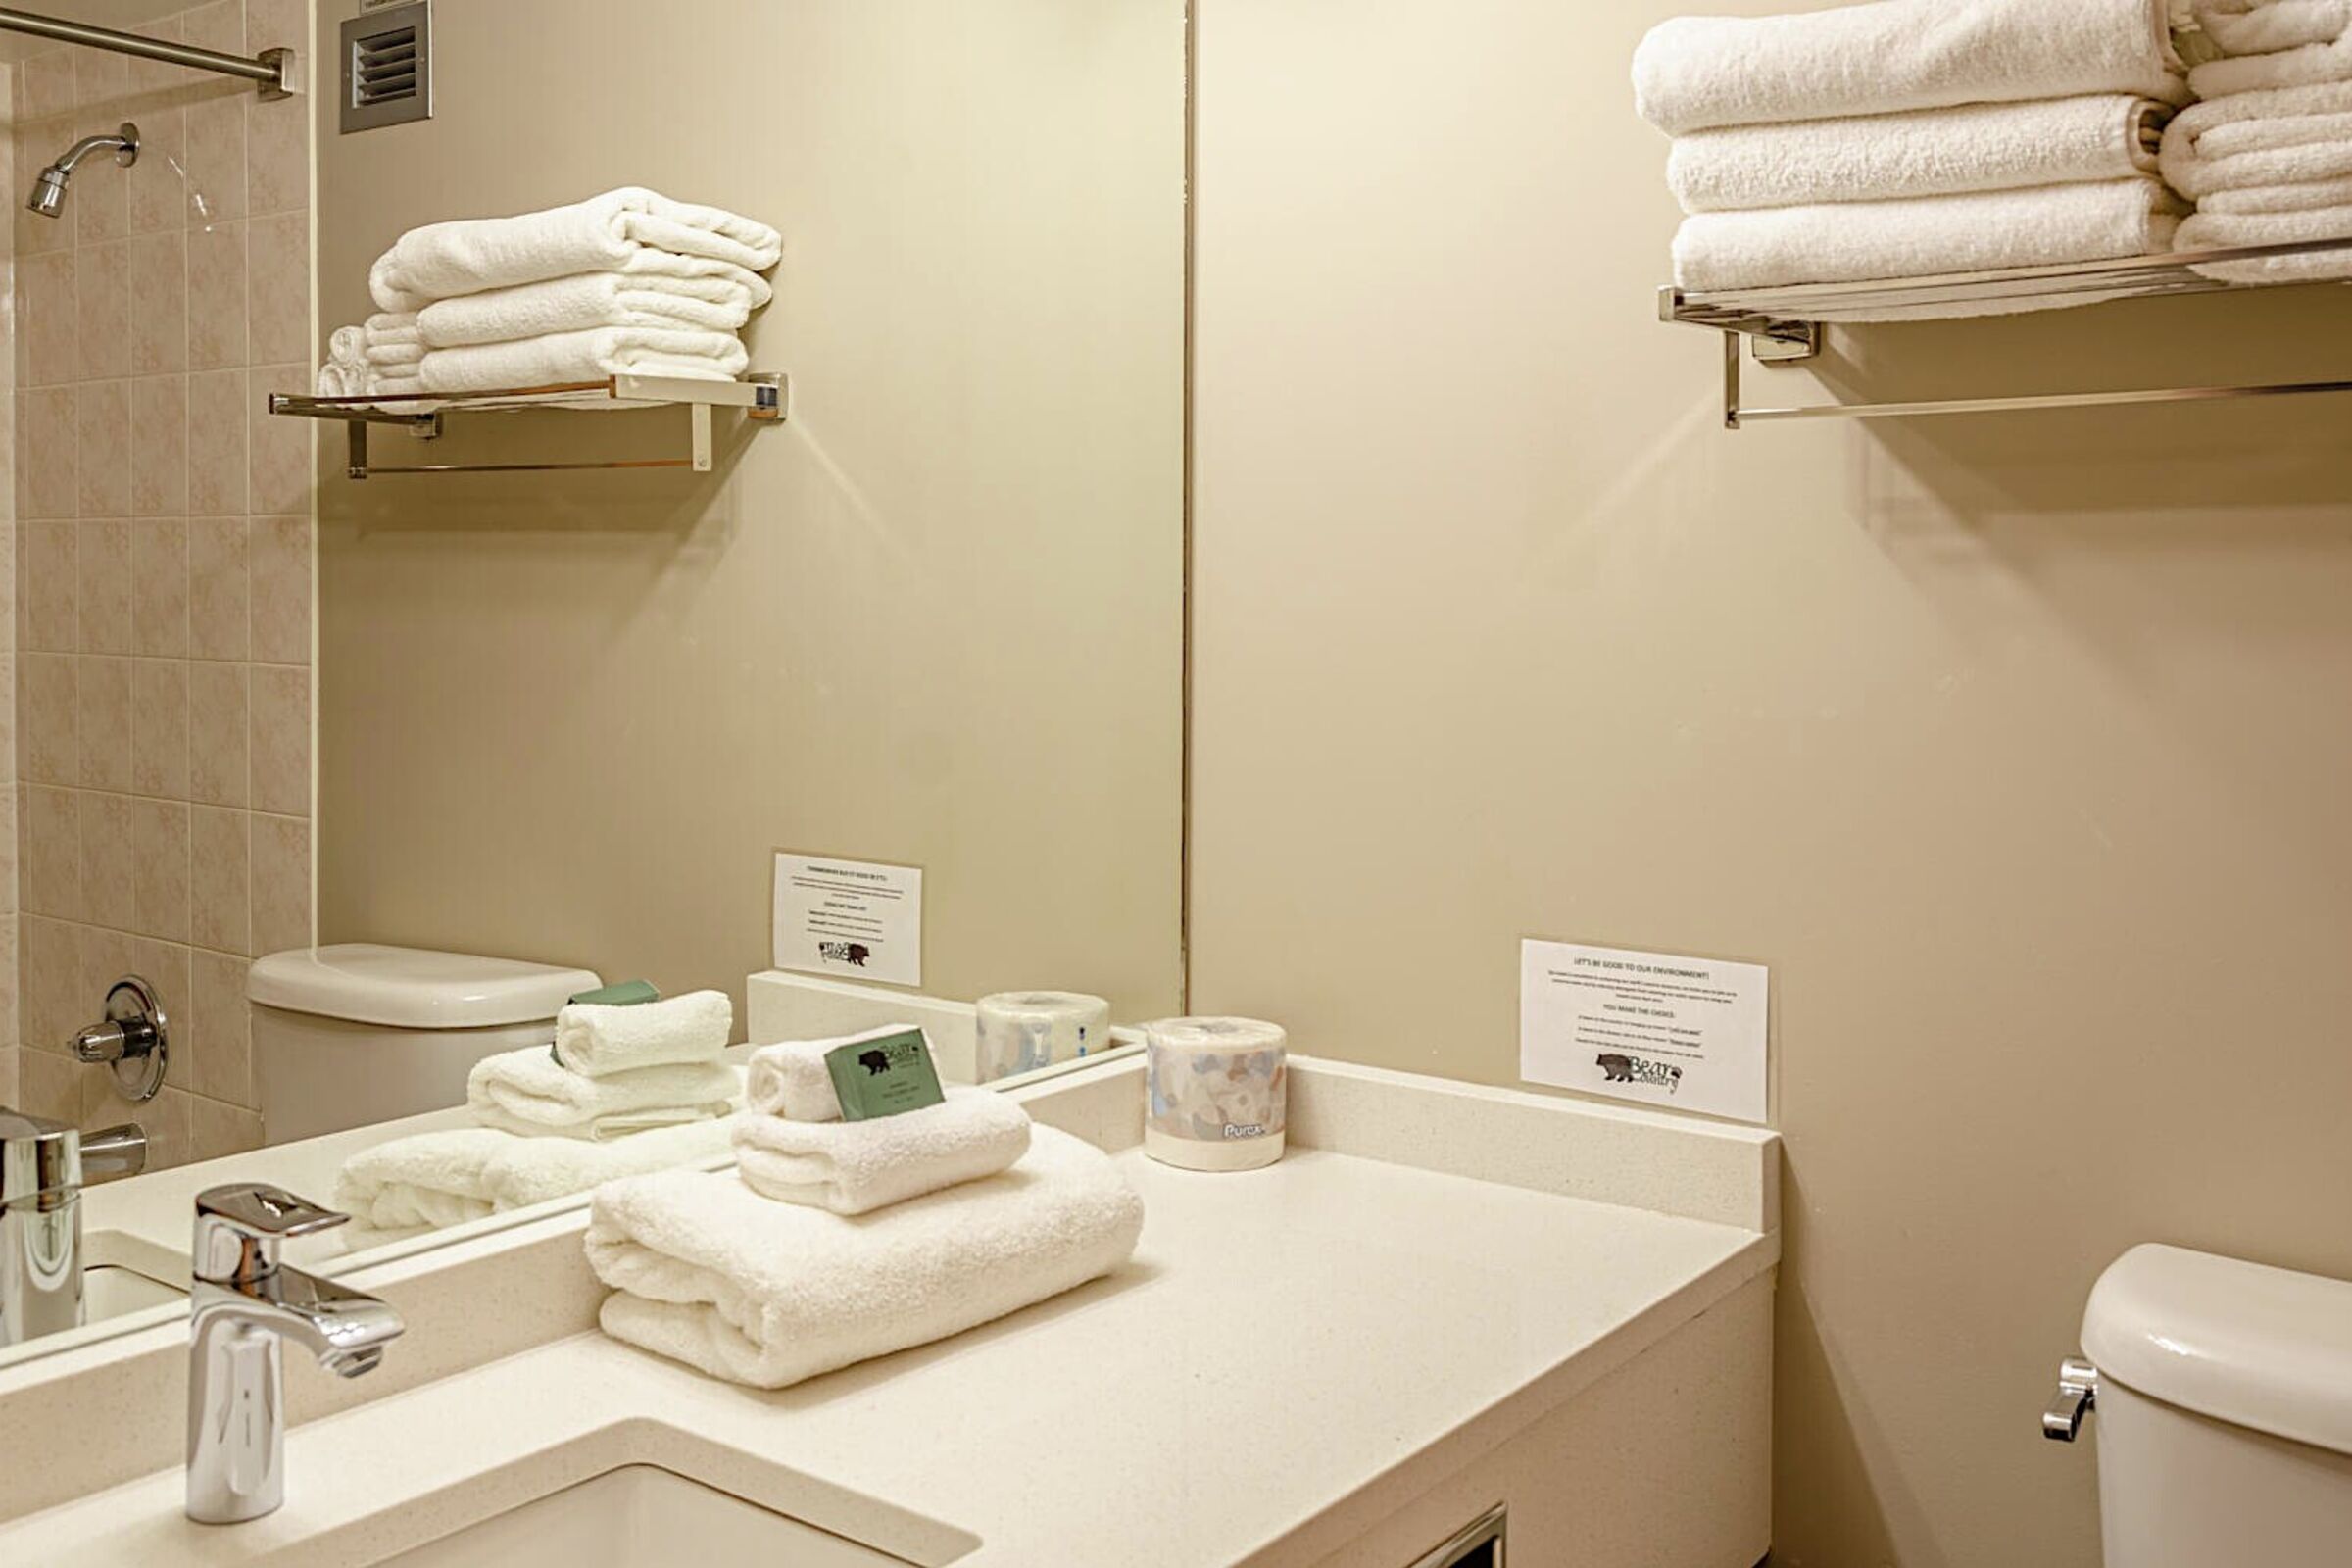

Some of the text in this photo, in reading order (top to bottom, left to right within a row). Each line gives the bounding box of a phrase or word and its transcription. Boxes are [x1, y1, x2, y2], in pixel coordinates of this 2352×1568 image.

[1625, 962, 1636, 971] TO
[1627, 1055, 1672, 1077] Bear
[1223, 1123, 1262, 1138] Purex
